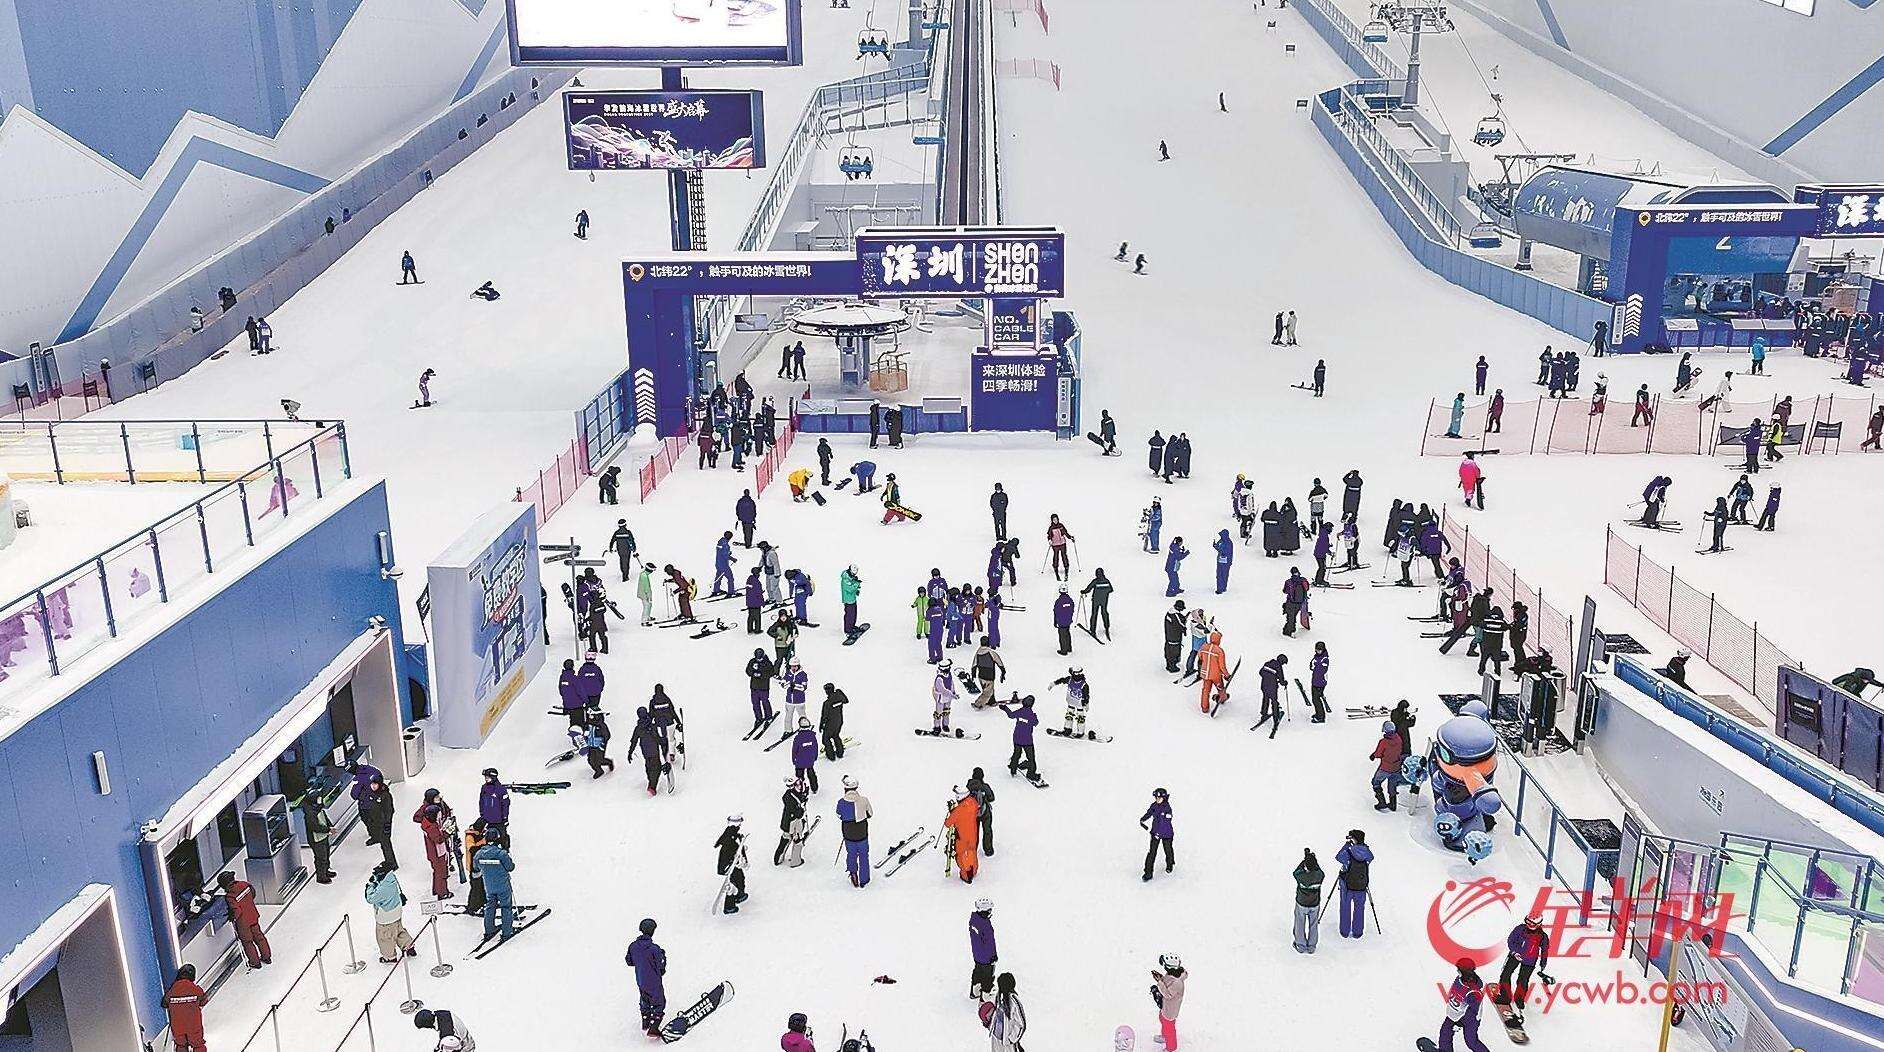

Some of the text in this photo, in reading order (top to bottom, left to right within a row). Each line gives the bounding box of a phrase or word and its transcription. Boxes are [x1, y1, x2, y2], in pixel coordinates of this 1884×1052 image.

[882, 242, 964, 285] 深圳
[993, 305, 1035, 324] NO. 1
[994, 325, 1034, 333] CABLE
[994, 333, 1020, 341] CAR
[982, 363, 1046, 377] 来深圳体验
